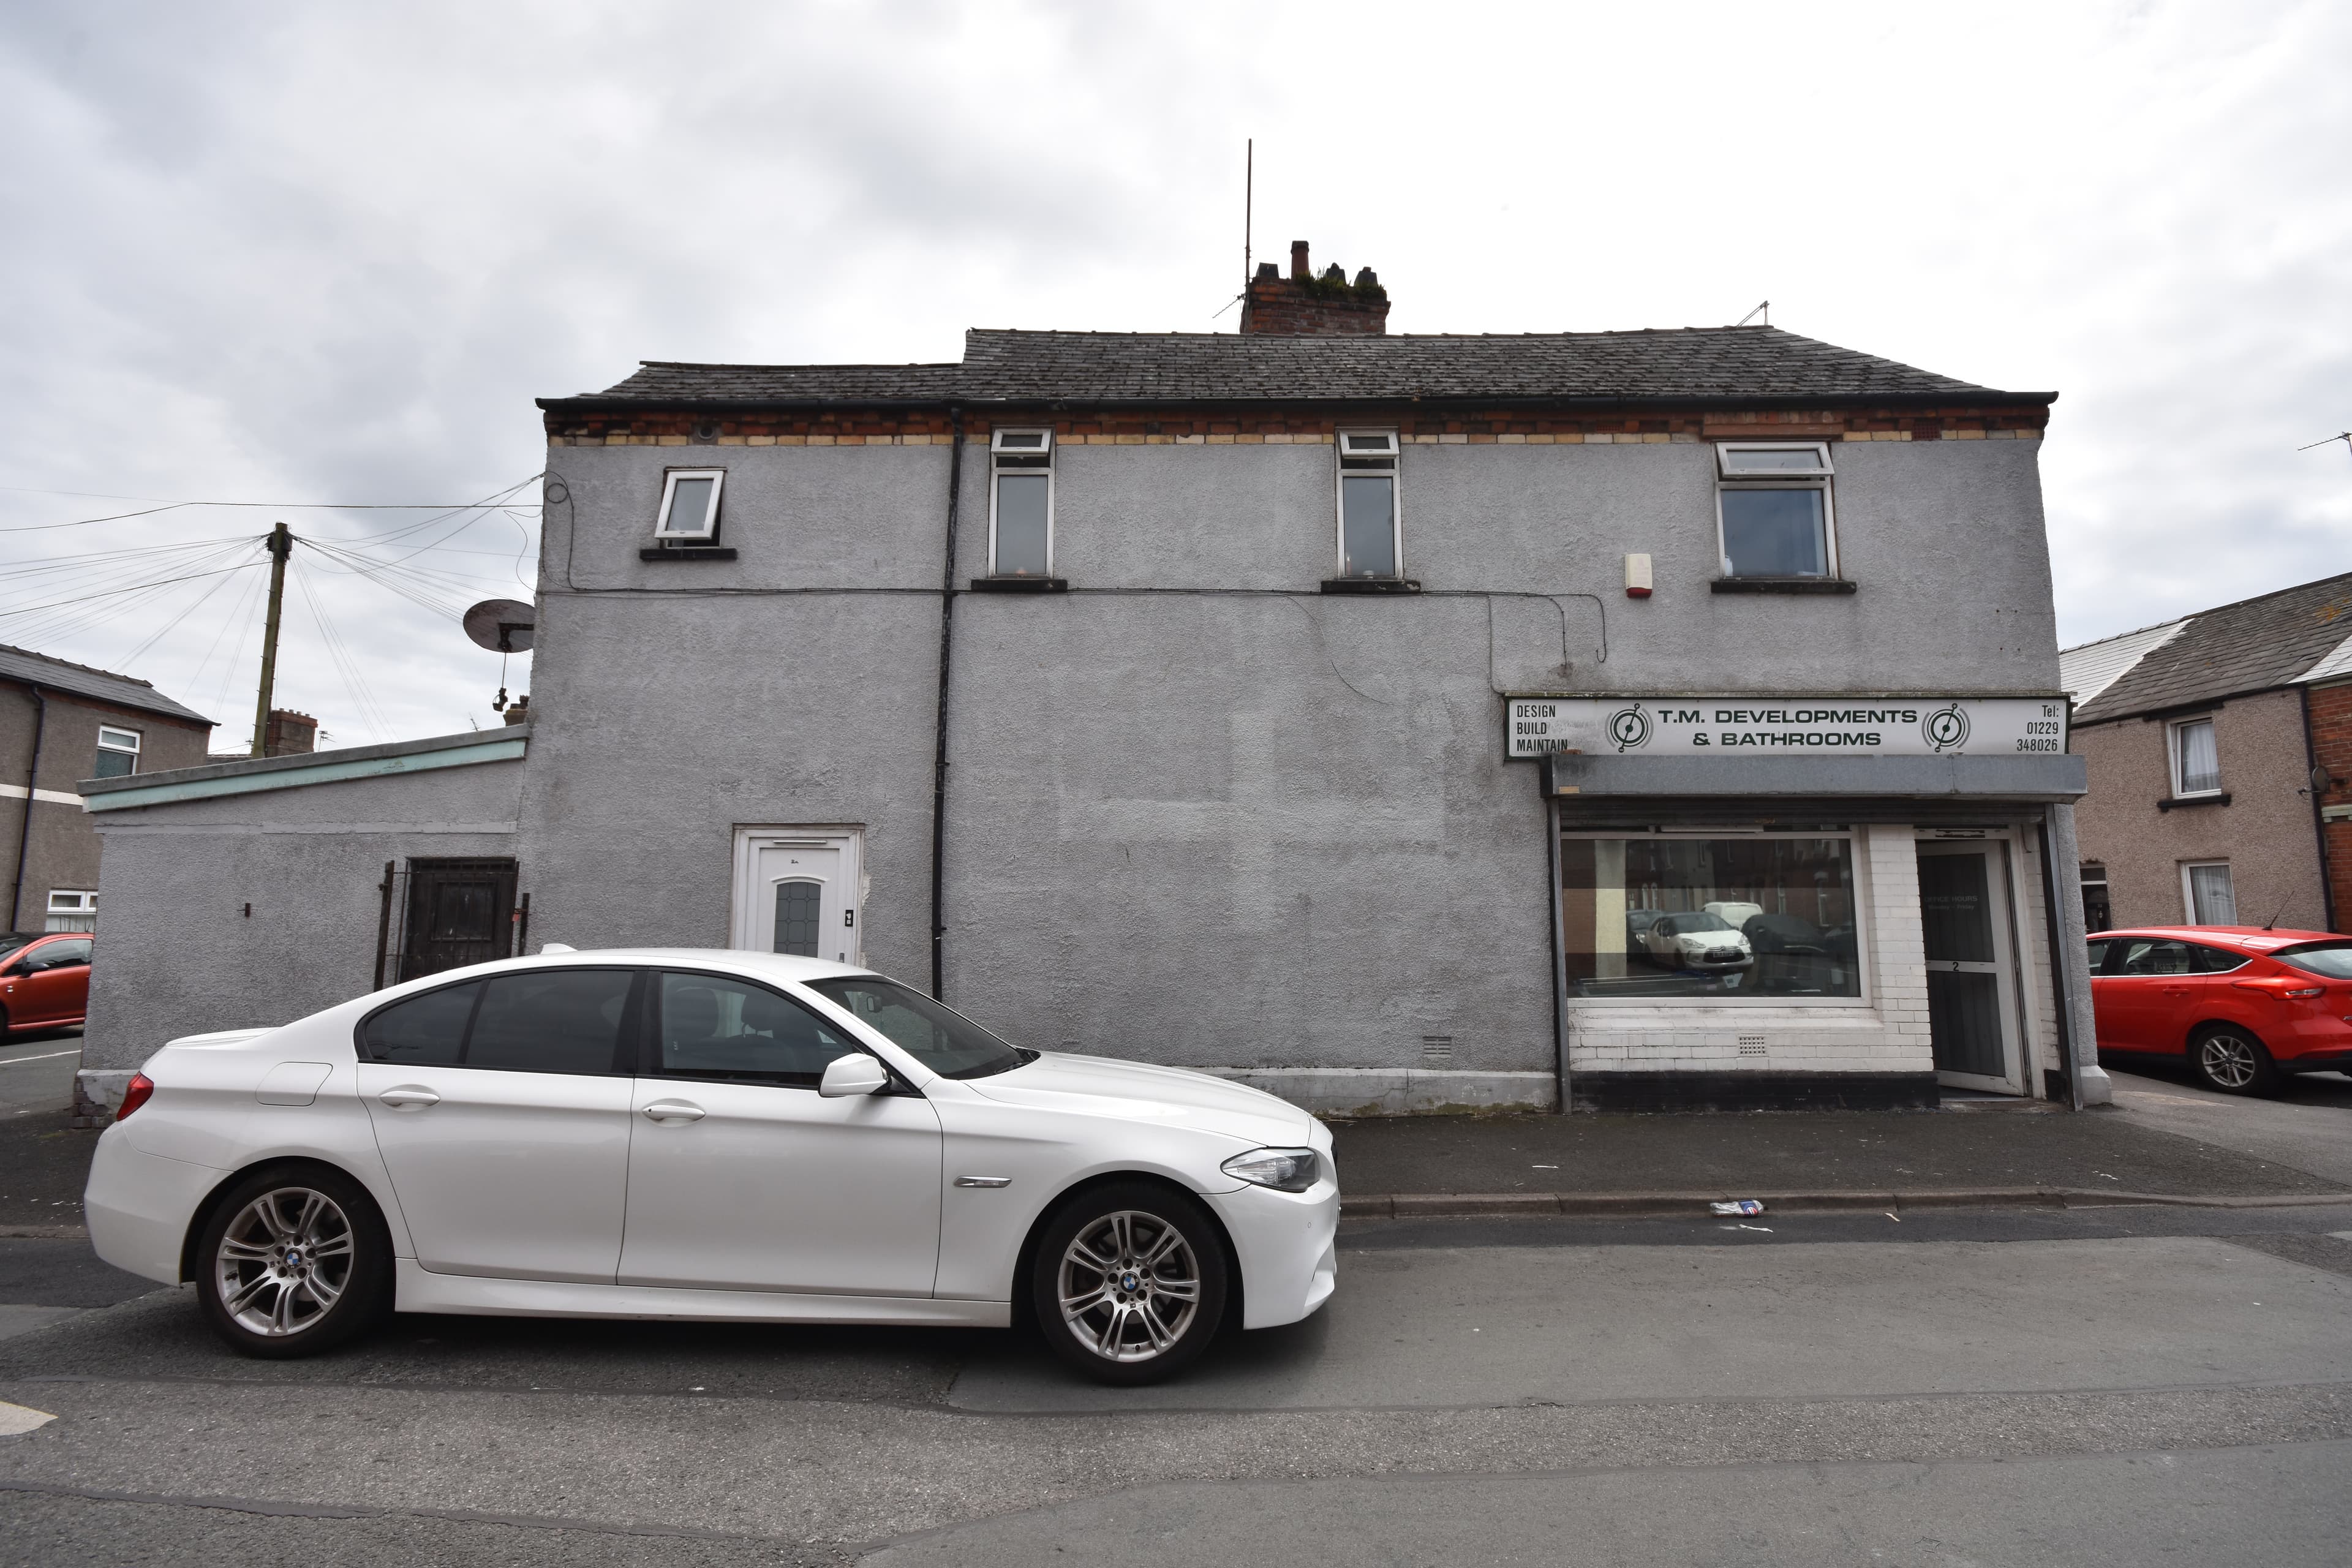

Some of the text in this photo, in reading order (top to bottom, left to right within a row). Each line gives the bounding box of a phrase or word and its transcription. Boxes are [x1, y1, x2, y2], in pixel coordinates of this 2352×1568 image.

[1517, 705, 1556, 718] DESIGN
[1658, 710, 1918, 723] T.M. DEVELOPMENTS
[2041, 705, 2059, 717] Tel:
[1517, 722, 1547, 735] BUILD
[2027, 722, 2059, 734] 01229
[1517, 739, 1568, 752] MAINTAIN
[1692, 733, 1881, 746] & BATHROOMS
[2016, 739, 2058, 752] 348026
[1953, 962, 1959, 971] 2
